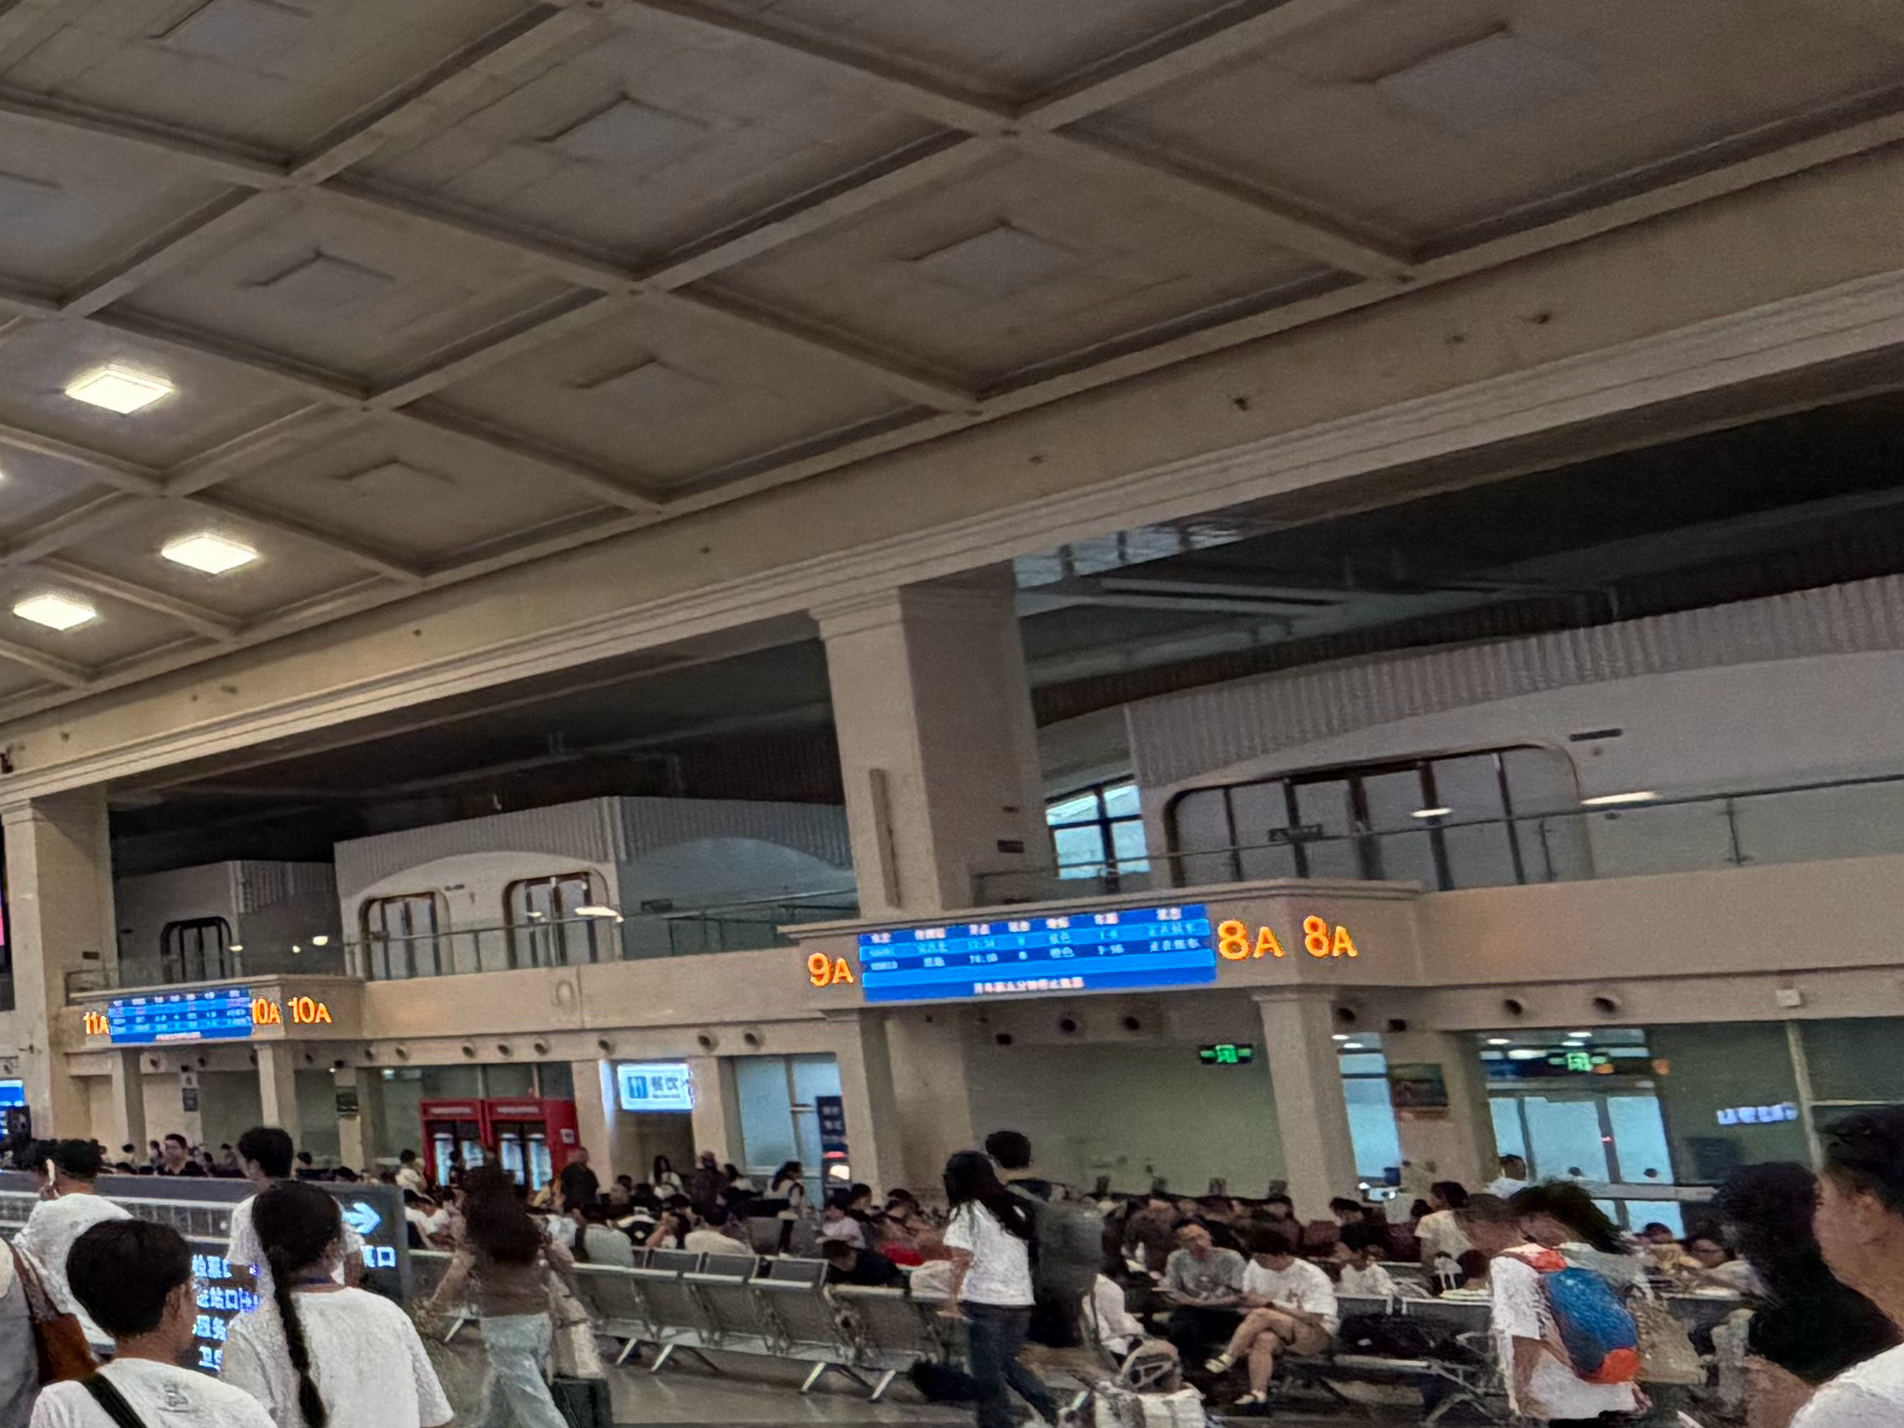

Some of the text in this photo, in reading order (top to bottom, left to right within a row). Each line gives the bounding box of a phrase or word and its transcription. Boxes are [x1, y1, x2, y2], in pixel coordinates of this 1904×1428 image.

[1217, 919, 1285, 960] 8A
[1303, 915, 1359, 959] 8A
[807, 952, 855, 988] 9A
[83, 1011, 110, 1036] 11A
[251, 997, 282, 1025] 10A
[287, 996, 333, 1024] 10A
